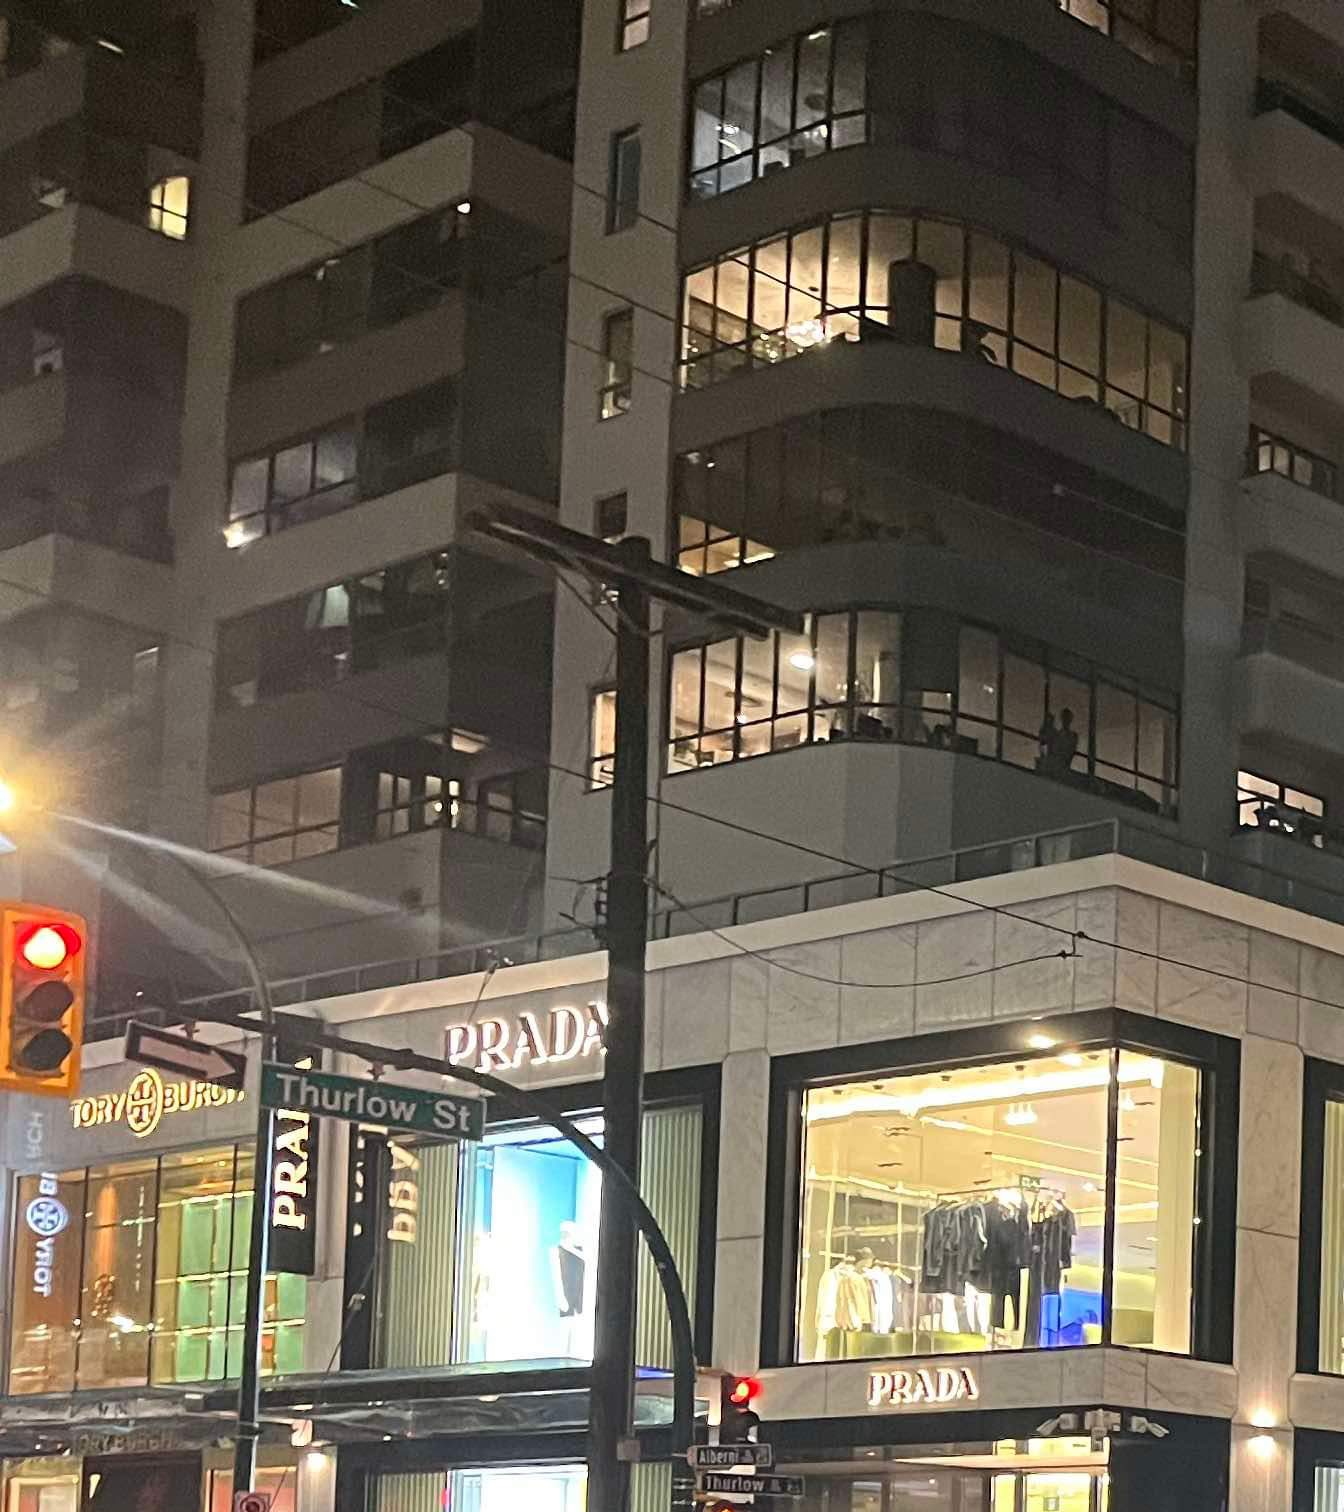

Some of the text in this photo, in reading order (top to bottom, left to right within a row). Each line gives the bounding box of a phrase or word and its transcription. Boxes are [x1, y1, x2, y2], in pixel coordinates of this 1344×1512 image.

[444, 1000, 608, 1074] PRADA
[70, 1091, 129, 1129] TORY
[276, 1072, 471, 1133] Thurlow St
[272, 1056, 313, 1231] PRA
[866, 1366, 979, 1406] PRADA
[699, 1447, 740, 1465] Alberni
[706, 1475, 765, 1493] Thurlow
